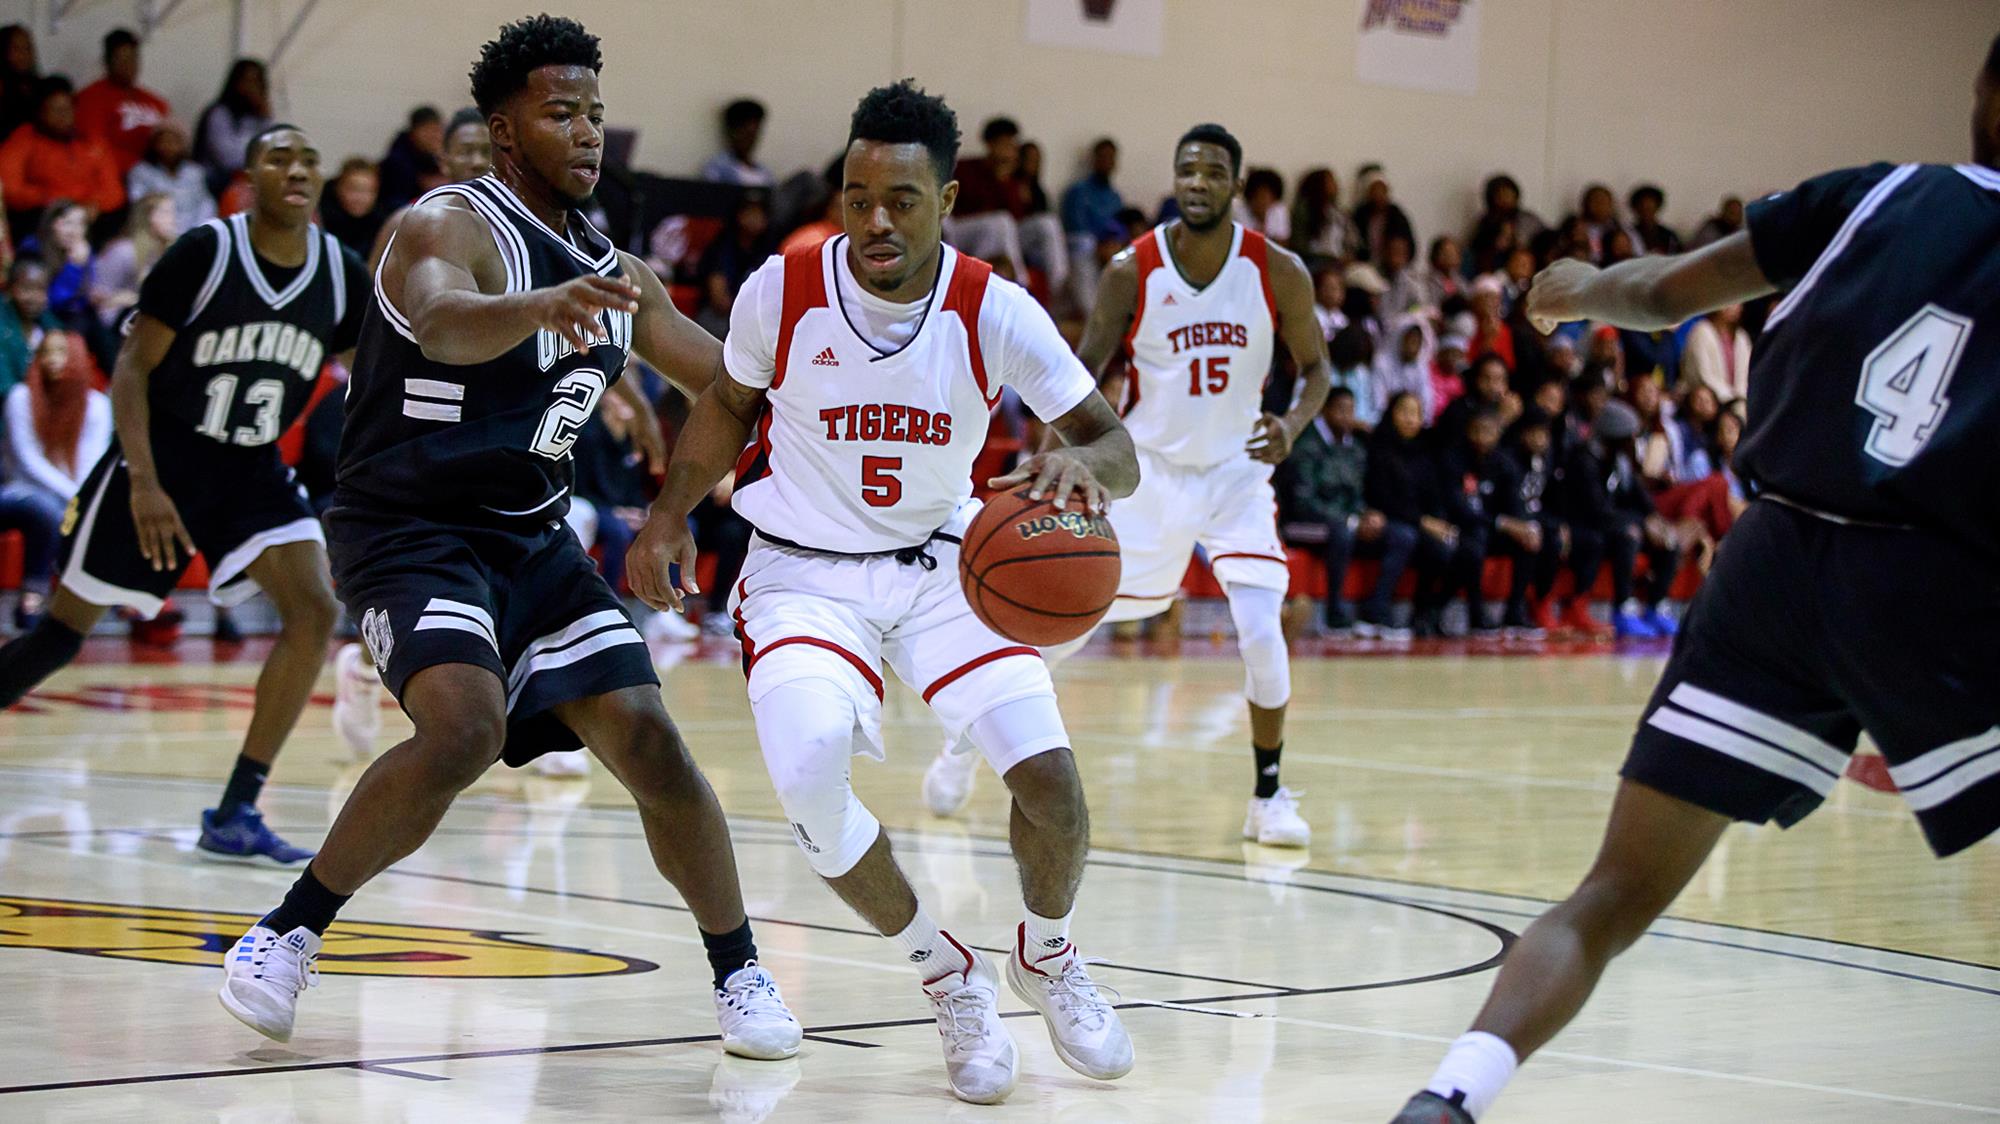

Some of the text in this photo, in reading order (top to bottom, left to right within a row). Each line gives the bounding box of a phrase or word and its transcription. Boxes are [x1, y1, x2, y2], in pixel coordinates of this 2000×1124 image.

[192, 320, 324, 381] OAKWOOD
[812, 358, 839, 367] adidas
[1167, 321, 1248, 353] TIGERS
[1189, 356, 1230, 396] 15
[1854, 301, 1974, 468] 4
[194, 372, 285, 447] 13
[528, 367, 606, 462] 2
[819, 403, 952, 446] TIGERS
[861, 455, 903, 507] 5
